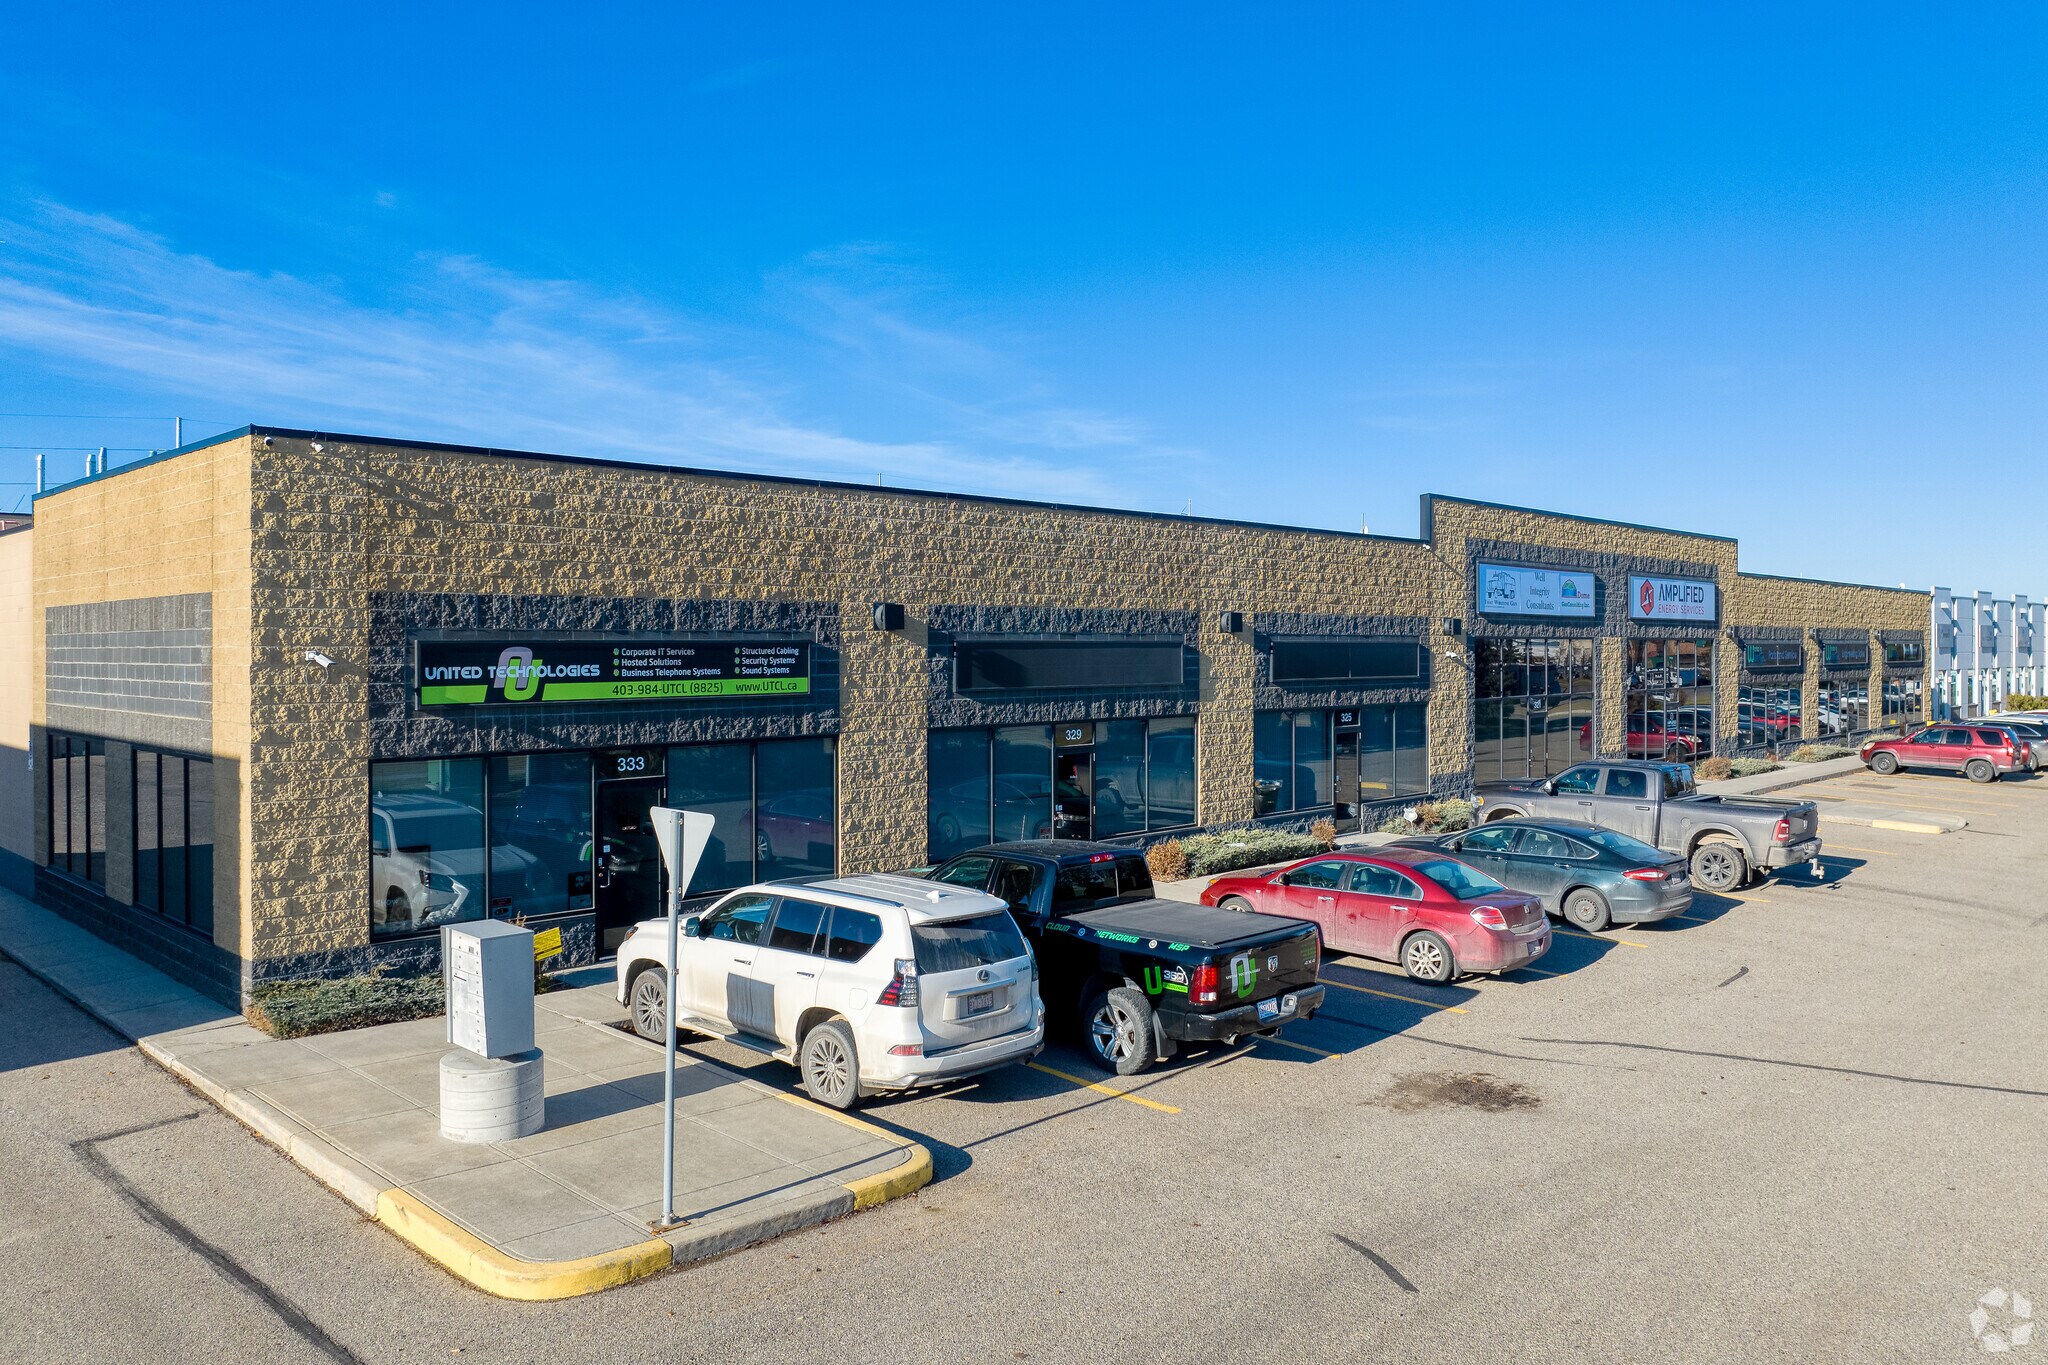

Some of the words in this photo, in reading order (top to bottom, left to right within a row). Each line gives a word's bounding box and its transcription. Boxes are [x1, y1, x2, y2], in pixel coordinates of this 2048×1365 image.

[1535, 572, 1546, 582] Well
[1530, 586, 1551, 598] Integrity
[1578, 591, 1590, 599] Dome
[1658, 583, 1704, 603] AMPLIFIED
[1526, 600, 1555, 611] Consultants
[1658, 604, 1679, 614] ENERGY
[1681, 605, 1705, 615] SERVICES
[621, 648, 657, 657] Corporate
[666, 648, 695, 656] Services
[741, 647, 776, 655] Structured
[776, 647, 799, 656] Cabling
[621, 658, 648, 667] Hosted
[649, 657, 682, 666] Solutions
[741, 657, 769, 666] Security
[769, 656, 796, 665] Systems
[425, 666, 483, 680] UNITED
[487, 664, 601, 679] TECHNOLOGIES
[621, 668, 654, 677] Business
[655, 667, 691, 677] Telephone
[692, 667, 721, 677] Systems
[741, 666, 763, 675] Sound
[763, 666, 790, 675] Systems
[612, 683, 687, 696] 403-984-UTCL
[689, 682, 723, 695] (8825)
[735, 681, 797, 692] www.UTCL.ca
[1341, 712, 1353, 722] 325
[1065, 729, 1082, 740] 329
[617, 756, 645, 772] 333
[1045, 921, 1071, 932] CLOUD
[1094, 930, 1139, 944] NETWORKS
[1168, 942, 1190, 952] MSP
